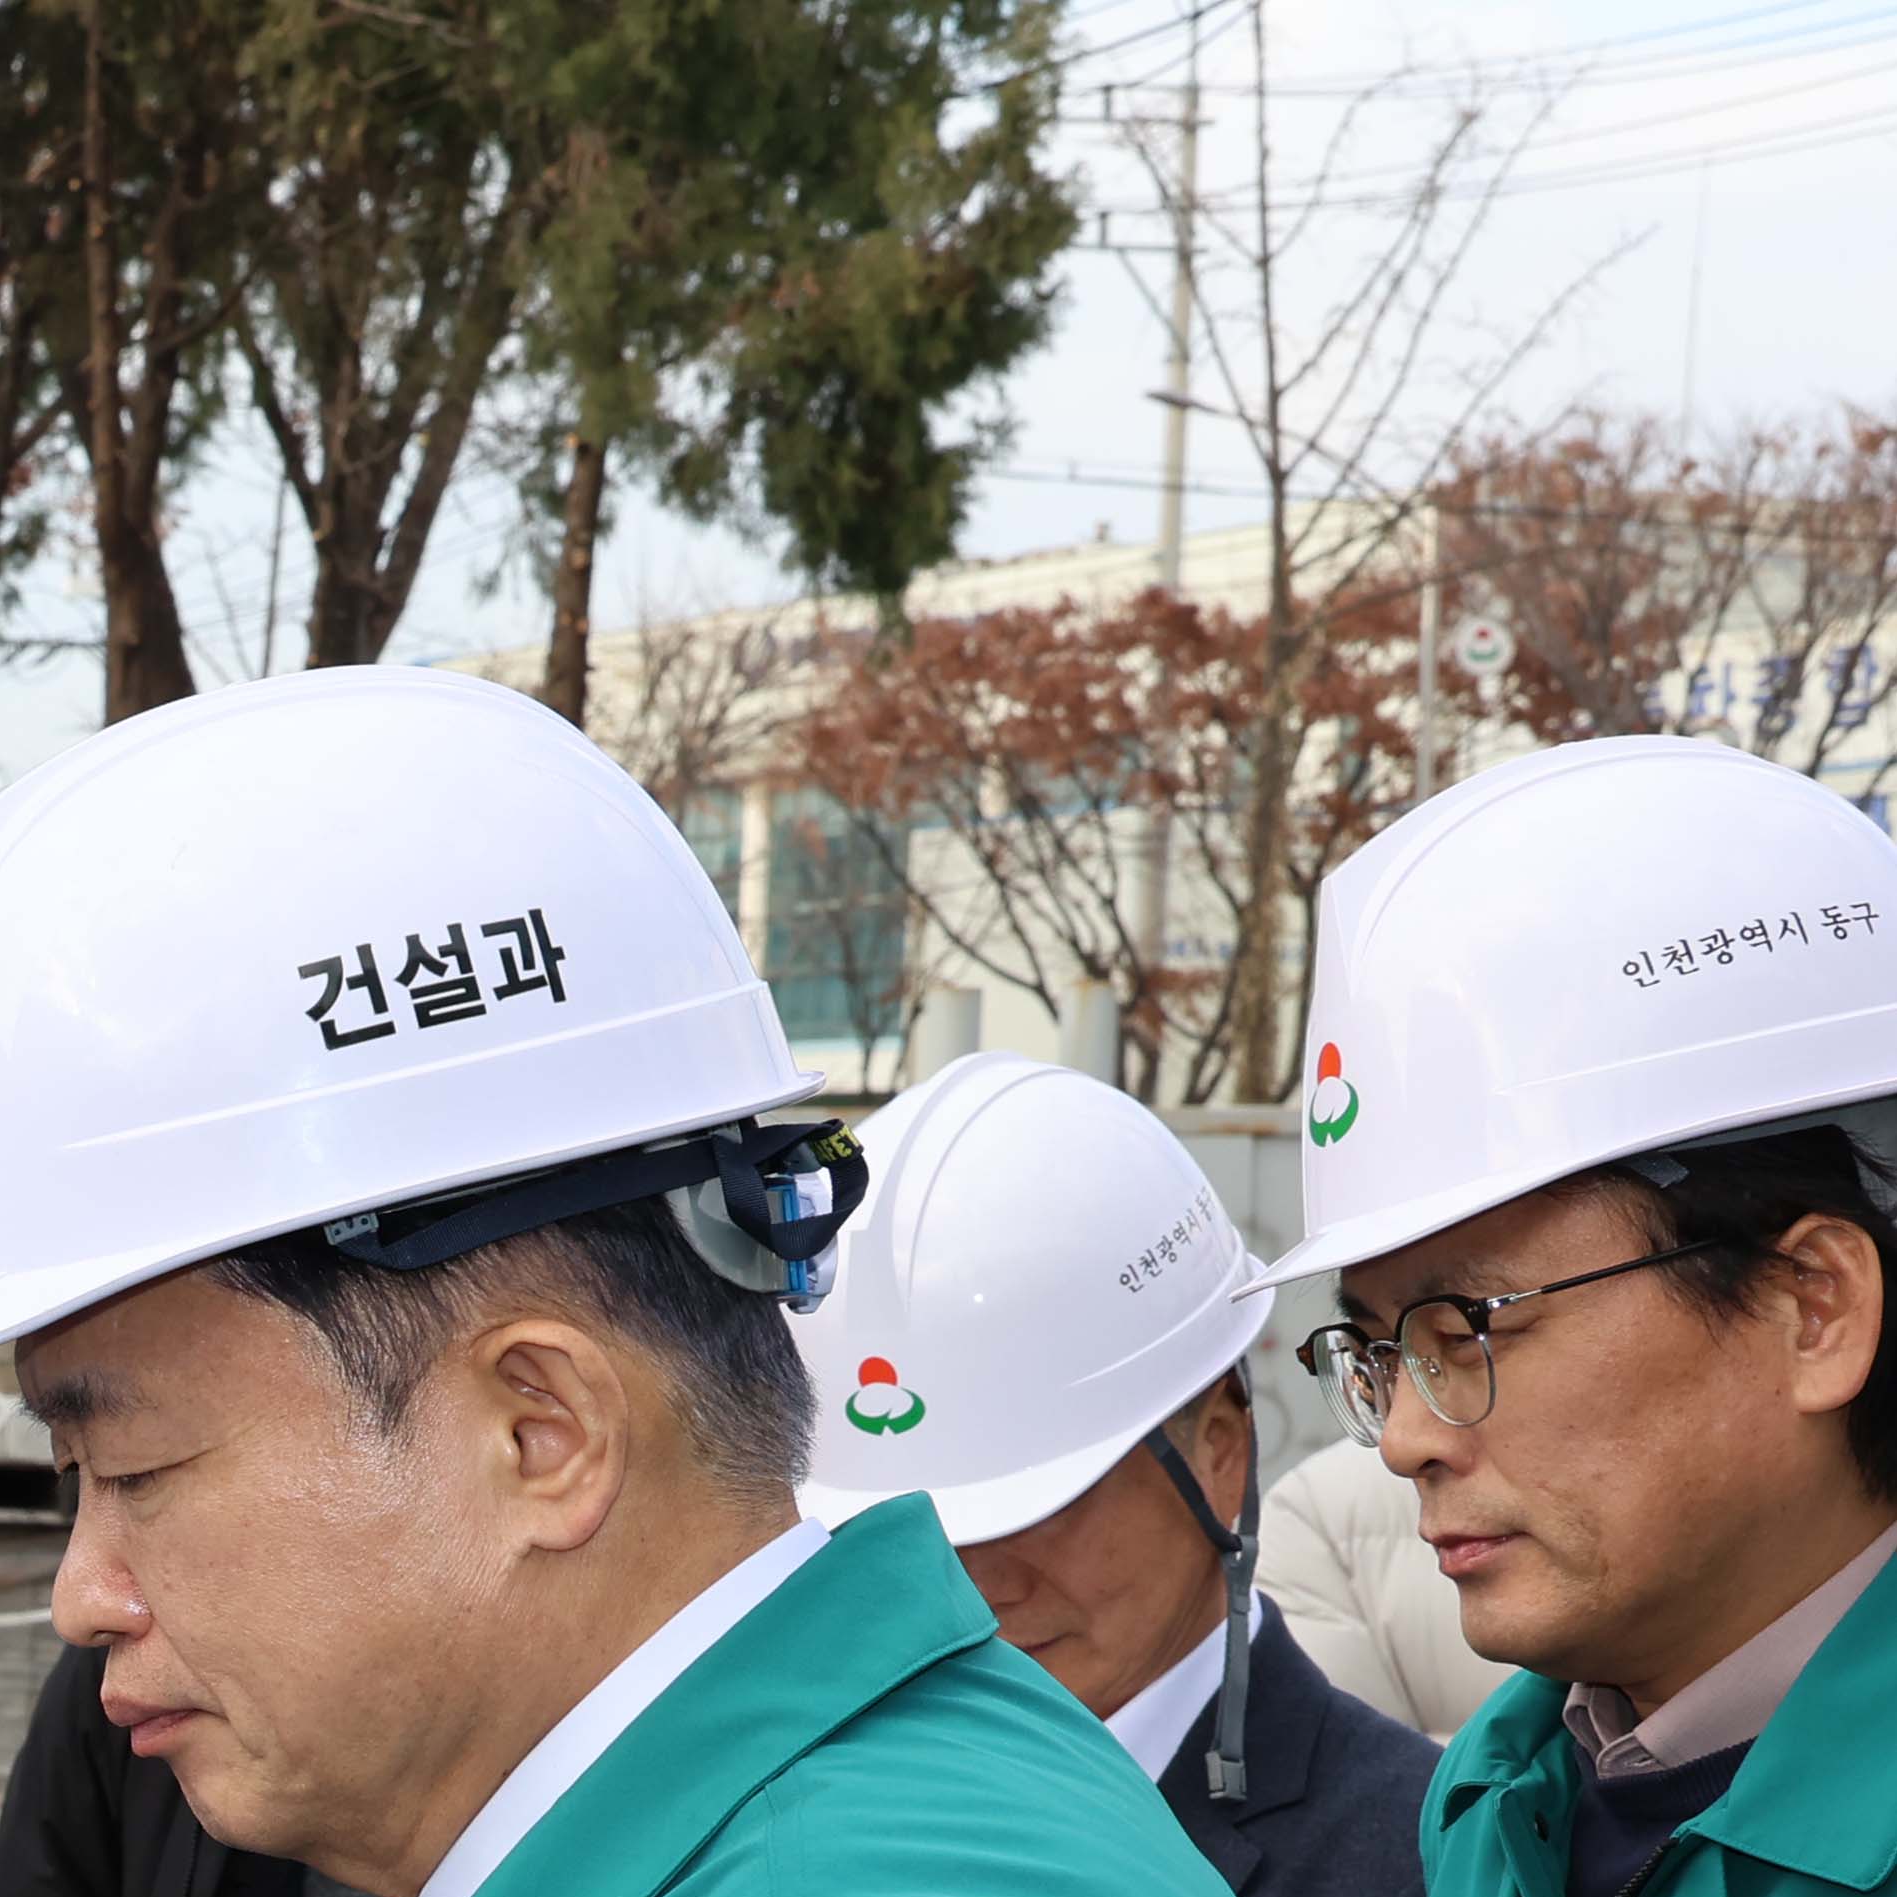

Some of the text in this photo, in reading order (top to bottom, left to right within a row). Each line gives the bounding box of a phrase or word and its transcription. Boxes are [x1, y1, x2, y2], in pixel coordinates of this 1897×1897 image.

[297, 908, 567, 1051] 건설과
[1622, 902, 1880, 988] 인천광역시 동구
[1119, 1207, 1203, 1293] 인천광역시
